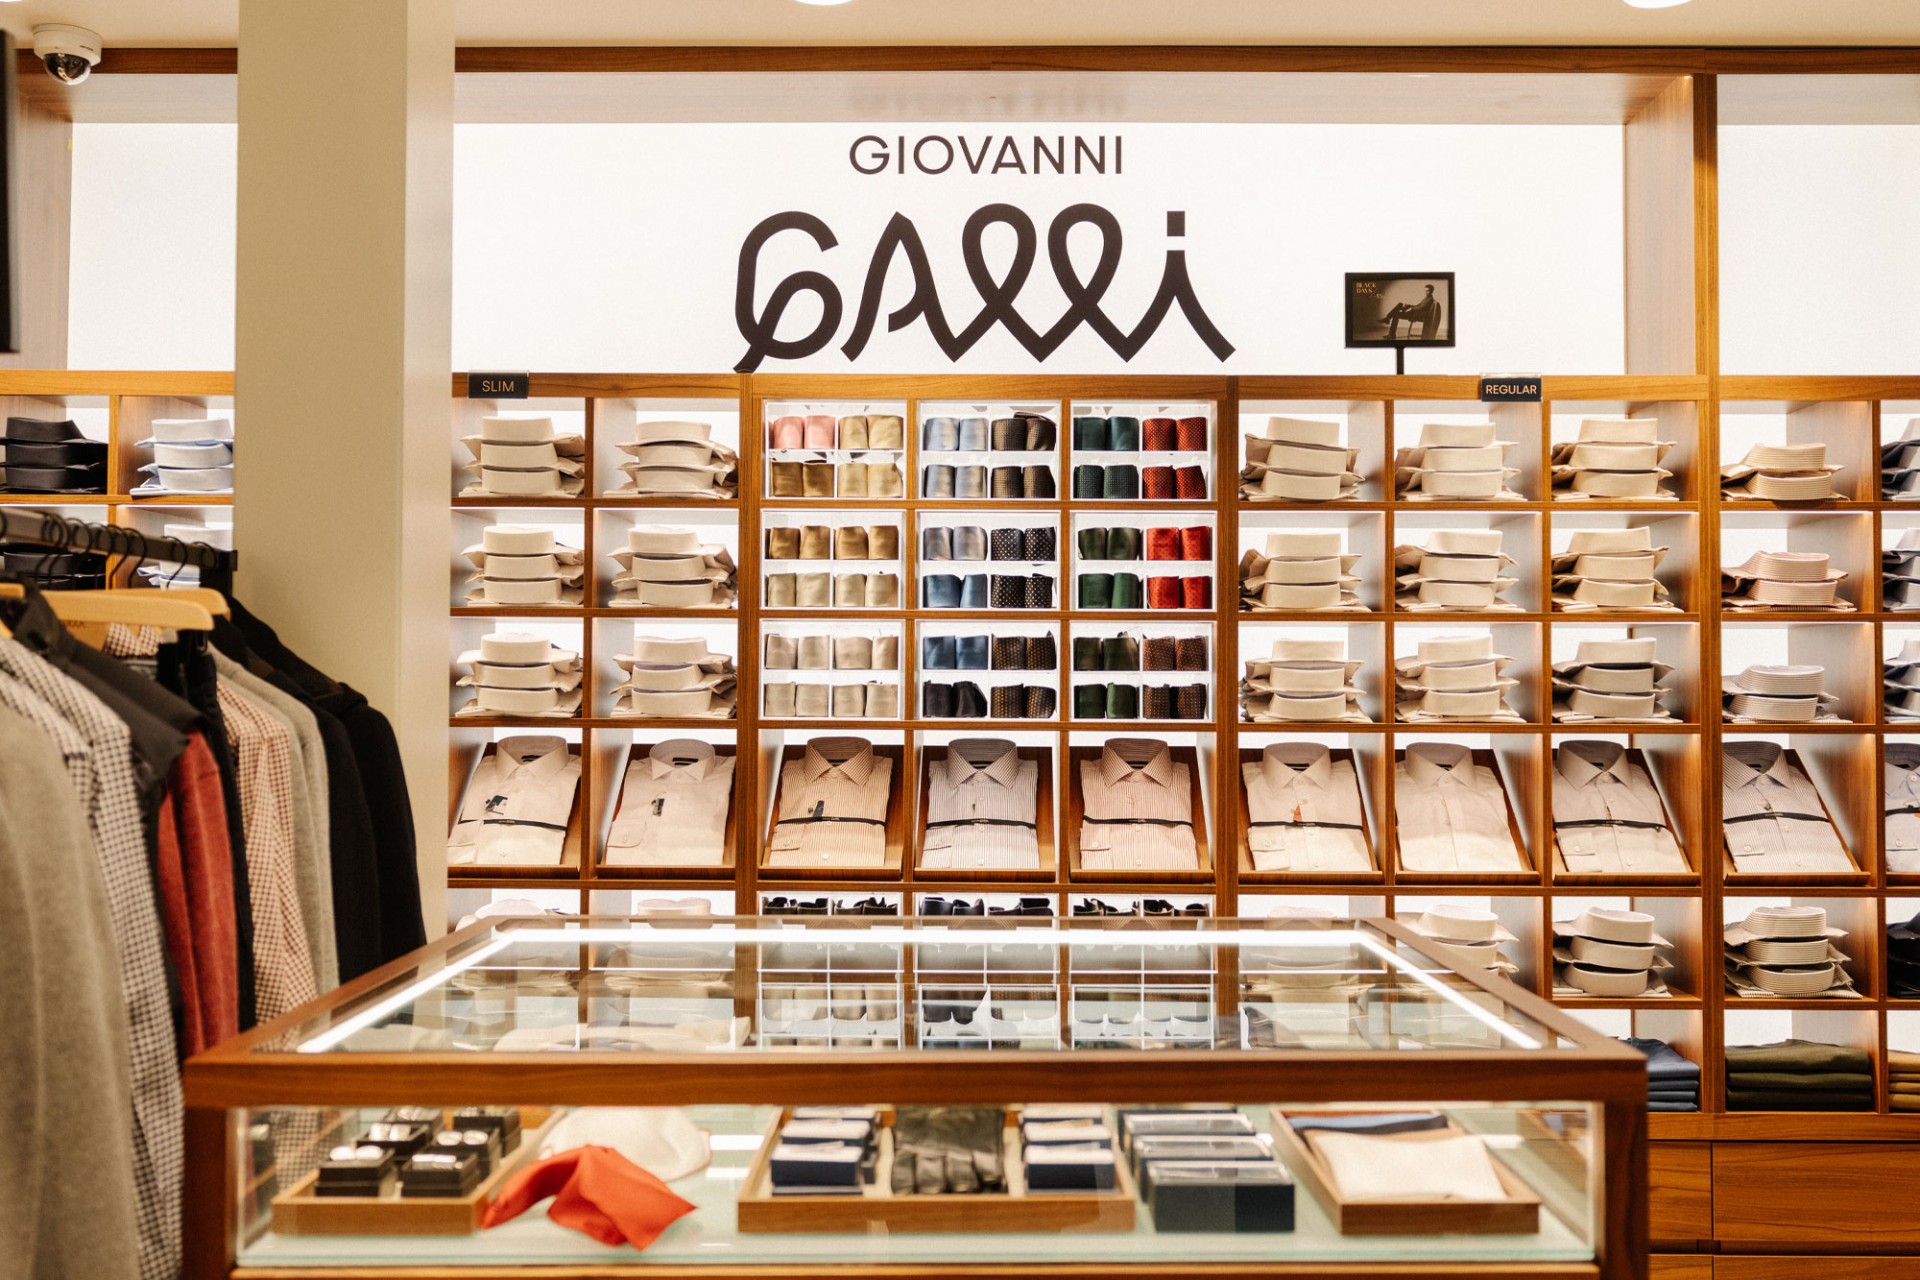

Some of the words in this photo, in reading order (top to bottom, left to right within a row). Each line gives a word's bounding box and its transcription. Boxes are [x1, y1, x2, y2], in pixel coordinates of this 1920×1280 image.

[849, 135, 1123, 175] GIOVANNI
[482, 380, 515, 392] SLIM
[1485, 384, 1537, 395] REGULAR
